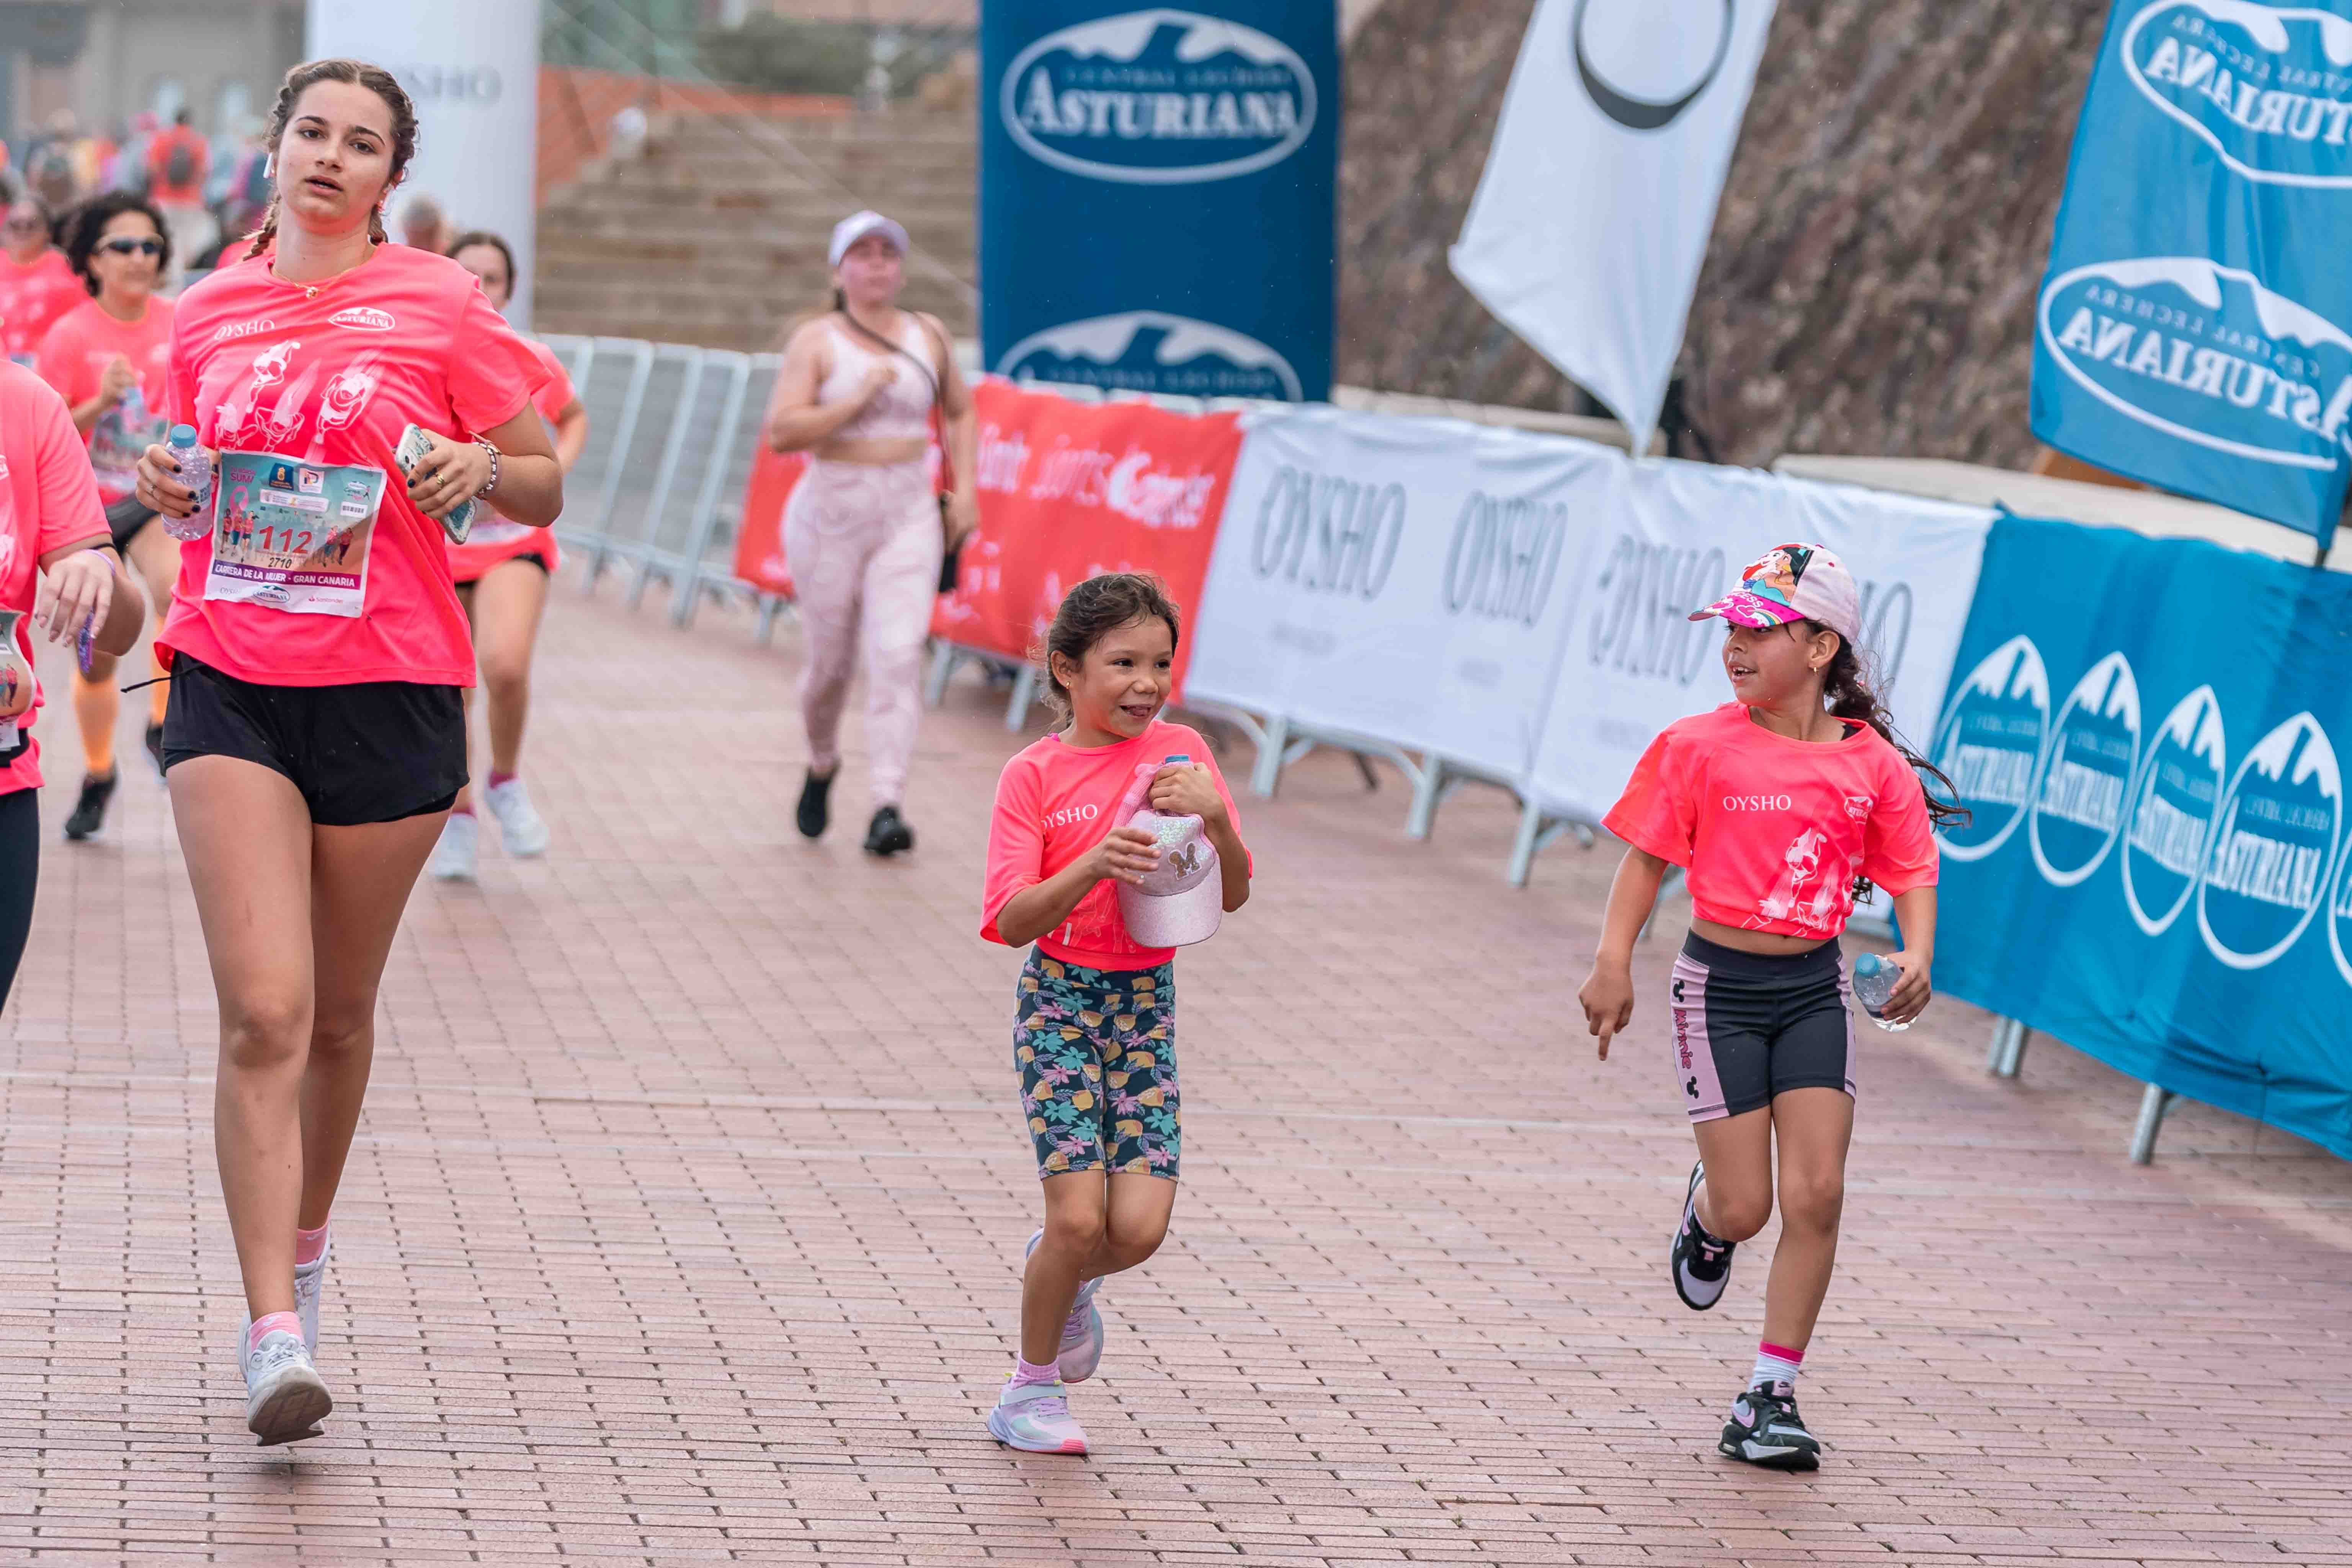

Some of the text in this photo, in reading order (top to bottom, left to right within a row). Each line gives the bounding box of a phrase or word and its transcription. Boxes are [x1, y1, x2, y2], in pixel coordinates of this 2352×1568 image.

[1019, 66, 1300, 139] ASTURIANA
[214, 319, 275, 340] OYSHO
[260, 526, 312, 554] 112
[1252, 463, 1406, 600] OYSHO
[268, 557, 292, 569] 2710
[1442, 488, 1568, 631] OYSHO
[215, 564, 242, 577] CARRERA
[243, 569, 253, 578] DE
[253, 570, 263, 580] LA
[265, 572, 286, 582] MUJER
[293, 575, 316, 583] GRAN
[317, 575, 355, 587] CANARIA
[1723, 794, 1792, 811] OYSHO
[2206, 795, 2322, 910] ASTURIANA
